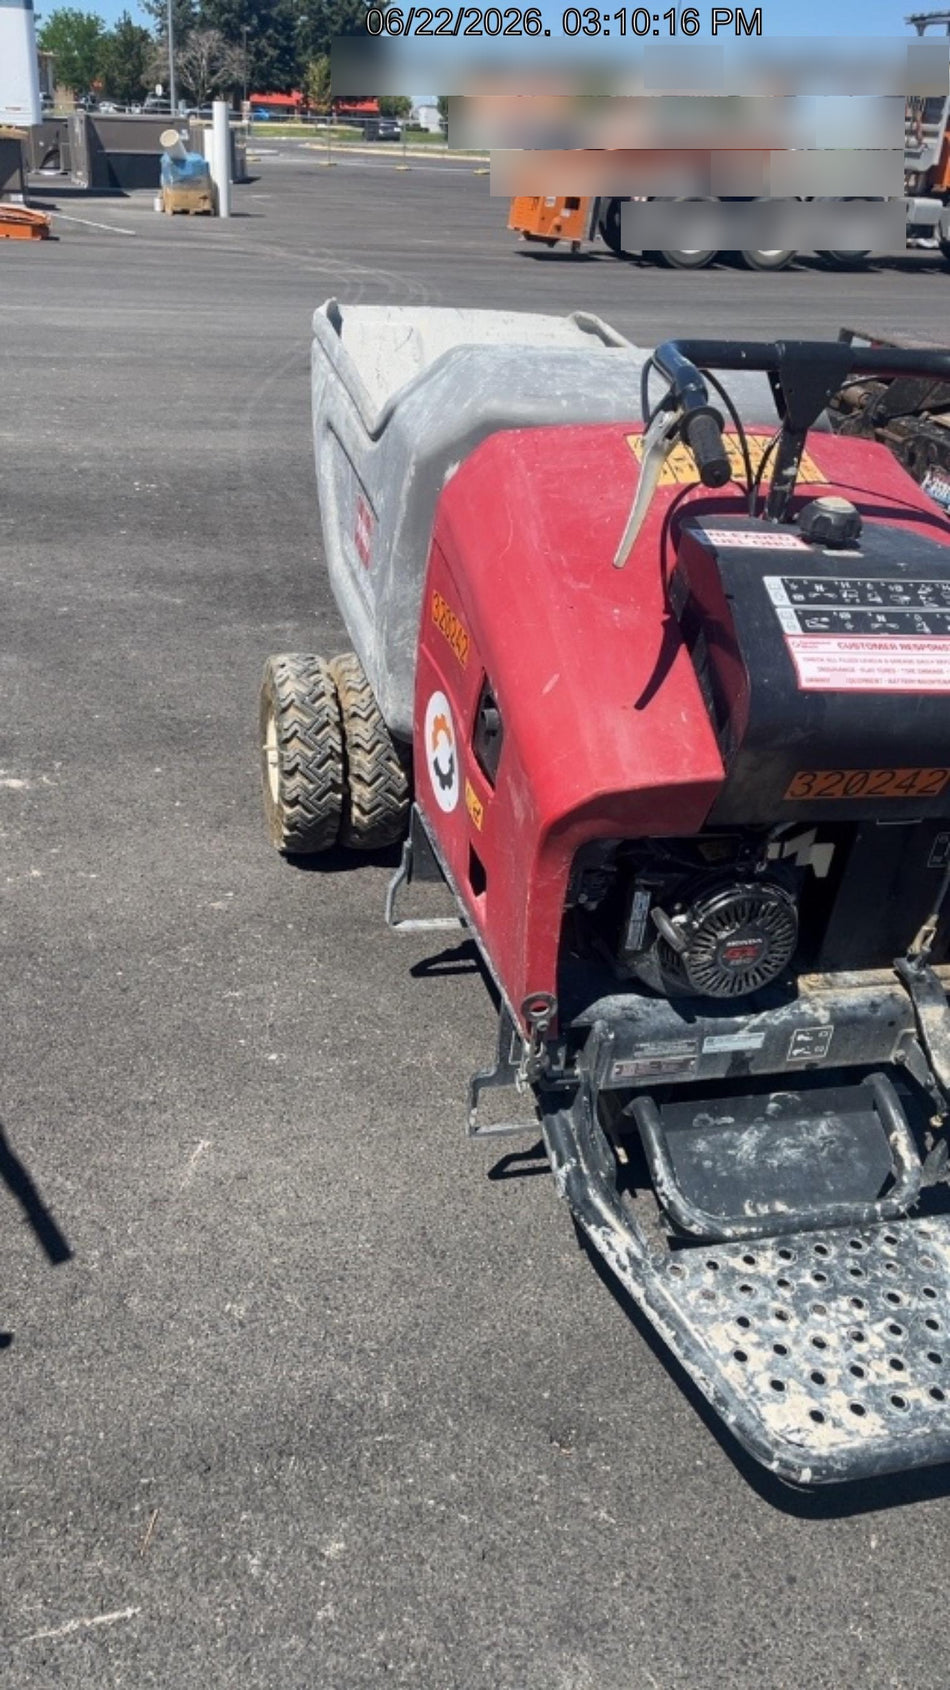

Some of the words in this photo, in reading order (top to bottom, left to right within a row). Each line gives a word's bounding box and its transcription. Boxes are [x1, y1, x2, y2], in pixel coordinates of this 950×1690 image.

[432, 592, 469, 664] 320242
[837, 641, 898, 651] CUSTOMER
[789, 770, 949, 798] 320242
[725, 938, 763, 947] HONDA
